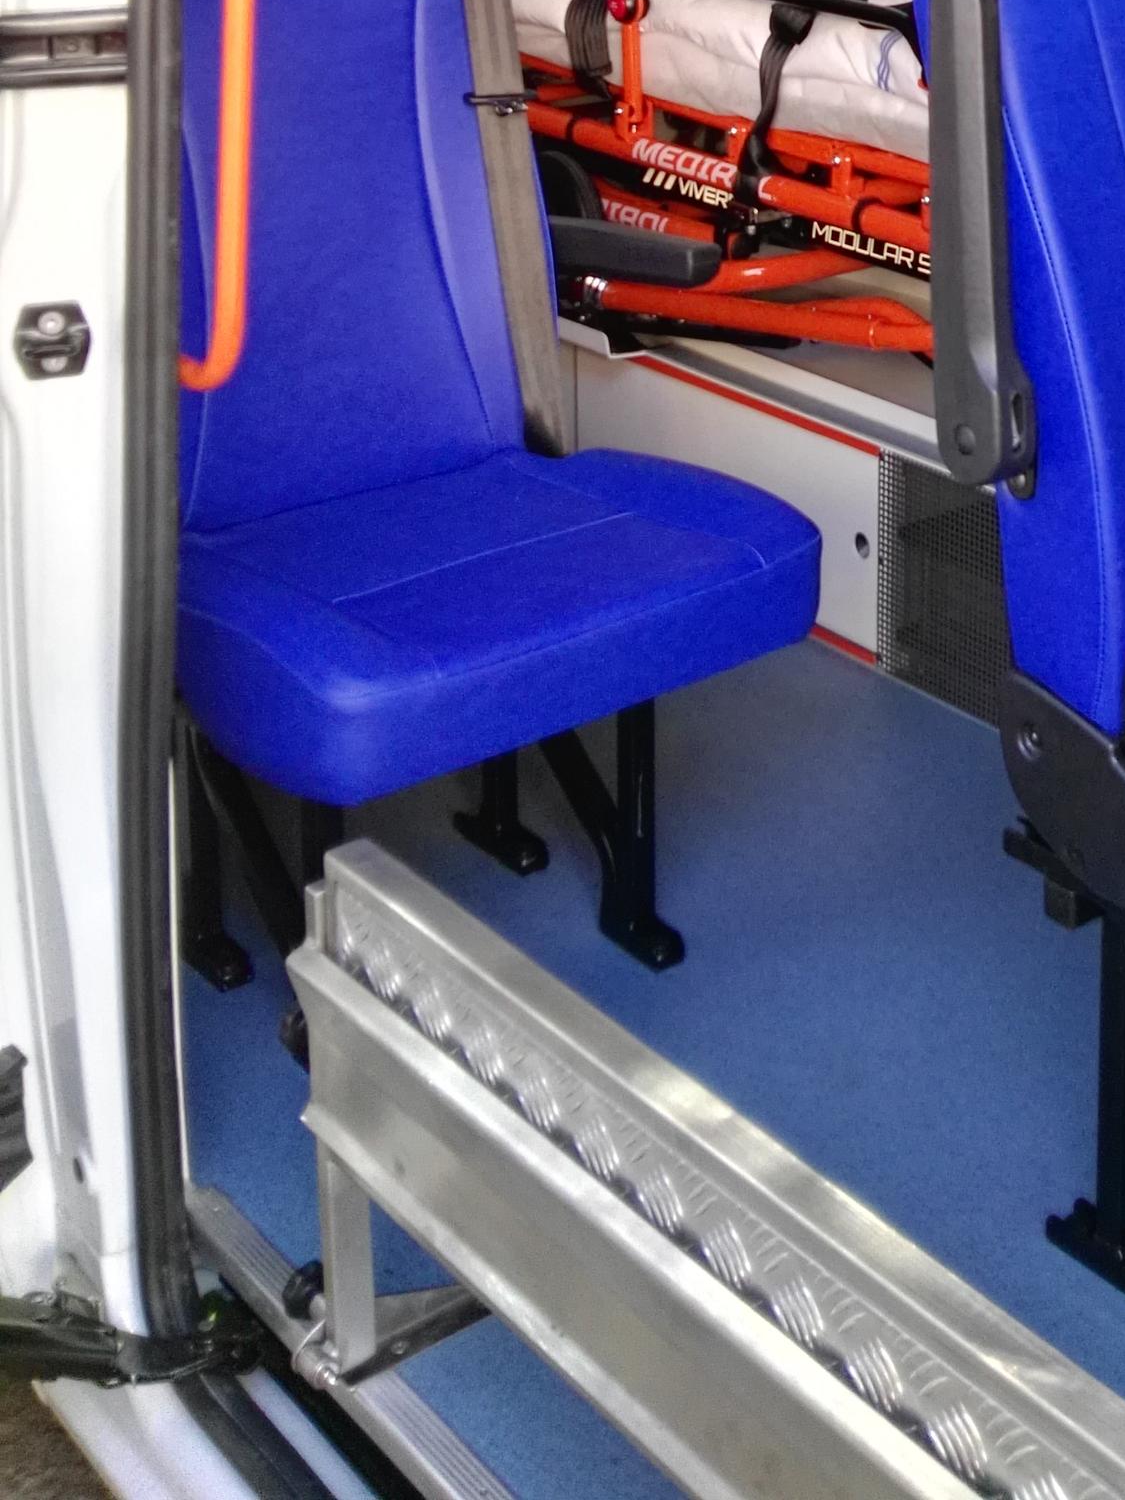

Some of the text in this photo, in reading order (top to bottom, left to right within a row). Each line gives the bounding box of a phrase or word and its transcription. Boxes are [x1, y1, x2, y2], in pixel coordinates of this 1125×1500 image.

[631, 138, 774, 200] MEDIRL
[678, 176, 735, 209] VIVER
[811, 221, 914, 269] MODULAR
